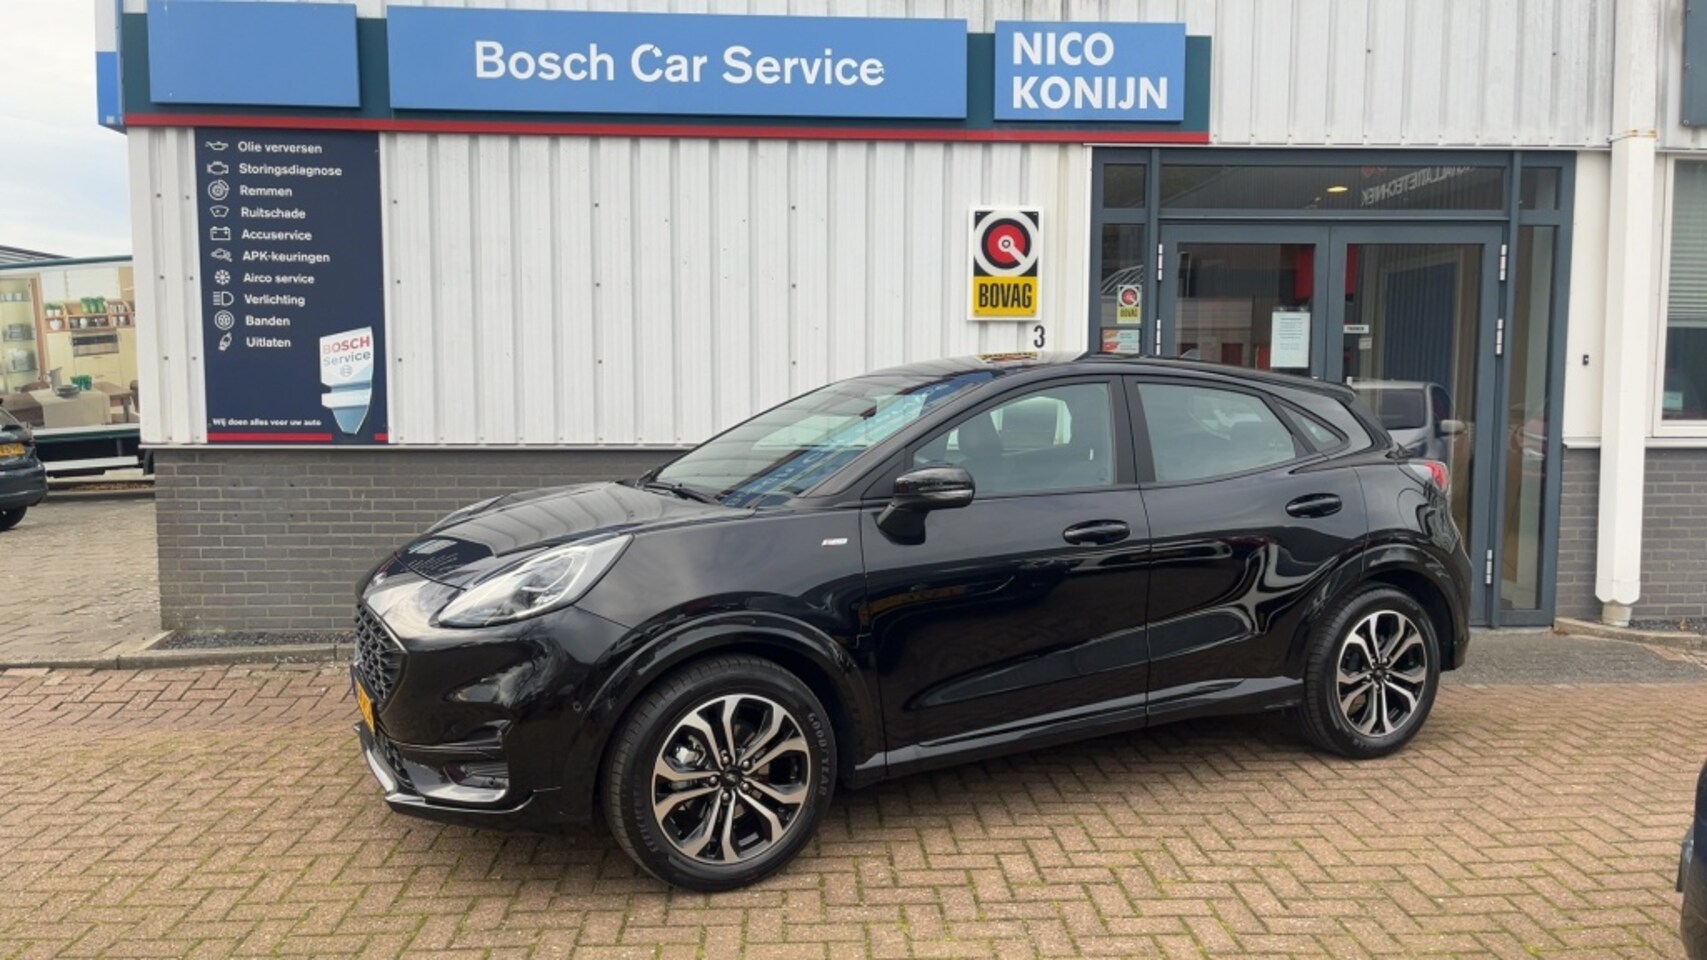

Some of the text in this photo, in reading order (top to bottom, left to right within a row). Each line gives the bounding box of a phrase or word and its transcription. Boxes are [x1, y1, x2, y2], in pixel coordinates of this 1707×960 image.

[1012, 31, 1115, 66] NICO
[474, 40, 885, 86] Bosch Car Service
[1012, 75, 1168, 110] KONIJN
[238, 141, 323, 154] Olie verversen
[239, 163, 342, 177] Storingsdiagnose
[240, 185, 293, 197] Remmen
[241, 206, 306, 219] Ruitschade
[242, 229, 313, 241] Accuservice
[242, 250, 331, 264] APK-keuringen
[243, 272, 315, 284] Airco service
[244, 293, 306, 307] Verlichting
[979, 283, 1032, 308] BOVAG
[245, 314, 291, 327] Banden
[246, 336, 292, 348] Uitlaten
[1033, 325, 1046, 348] 3
[323, 336, 370, 354] BOSCH
[323, 351, 371, 366] Service
[212, 418, 227, 427] Wij
[228, 418, 249, 426] doen
[249, 418, 269, 426] alles
